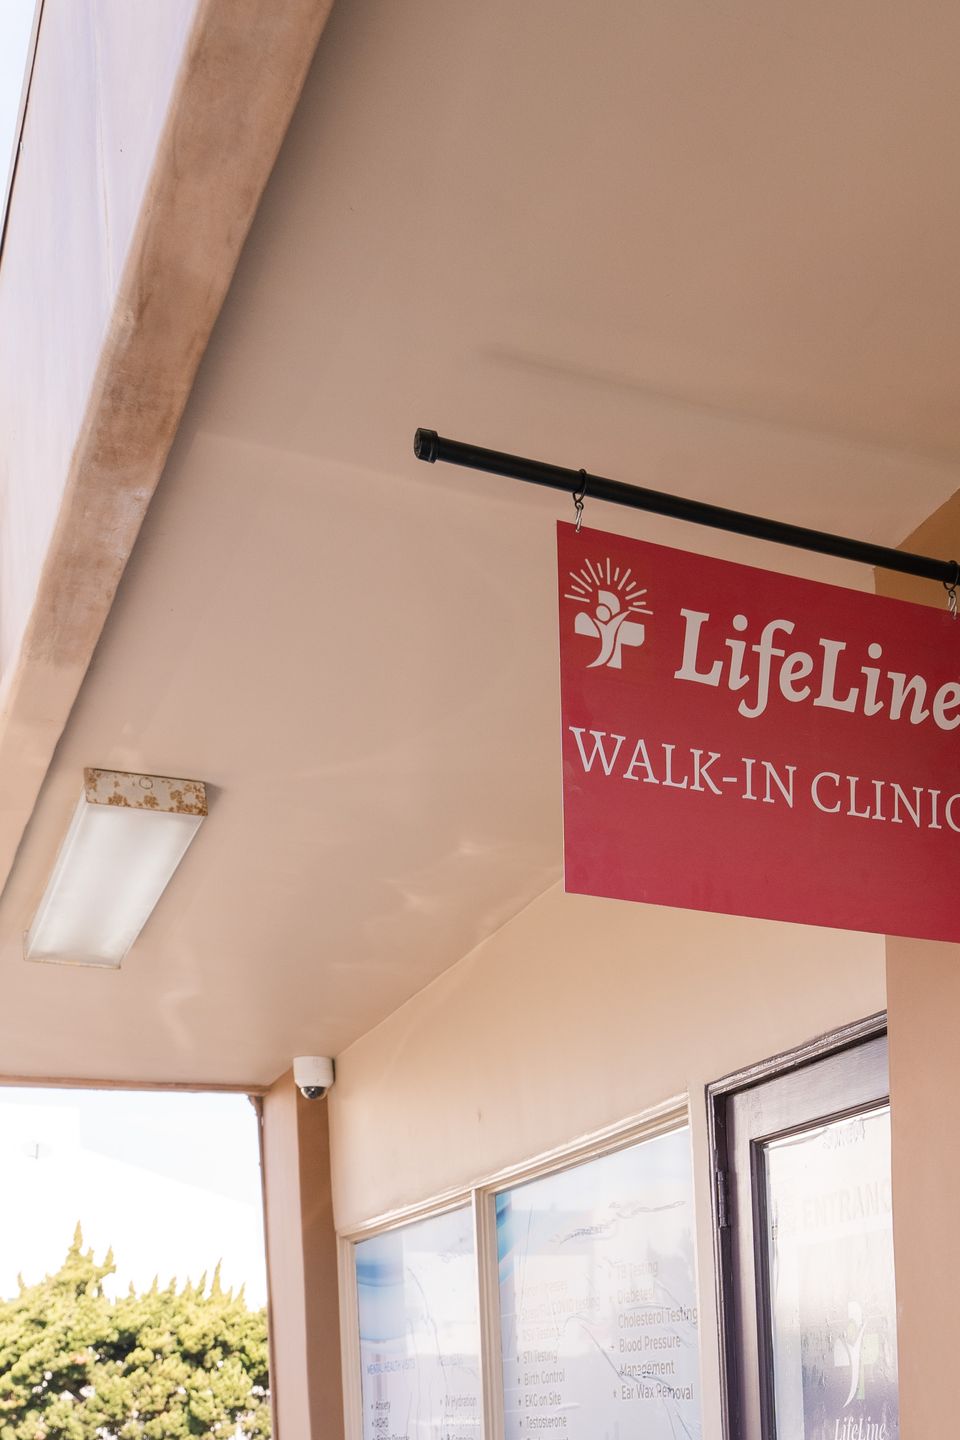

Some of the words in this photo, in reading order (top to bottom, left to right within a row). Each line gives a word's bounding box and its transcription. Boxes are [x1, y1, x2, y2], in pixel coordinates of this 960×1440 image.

[569, 726, 797, 809] WALK-IN
[618, 1310, 664, 1329] Cholesterol
[667, 1306, 698, 1326] Testing
[619, 1336, 643, 1353] Blood
[644, 1334, 682, 1352] Pressure
[524, 1372, 540, 1386] Birth
[541, 1368, 566, 1384] Control
[620, 1359, 675, 1377] Management
[548, 1391, 562, 1406] Site
[622, 1383, 635, 1400] Ear
[636, 1383, 655, 1400] Wax
[656, 1382, 695, 1401] Removal
[526, 1414, 567, 1430] Testosterone
